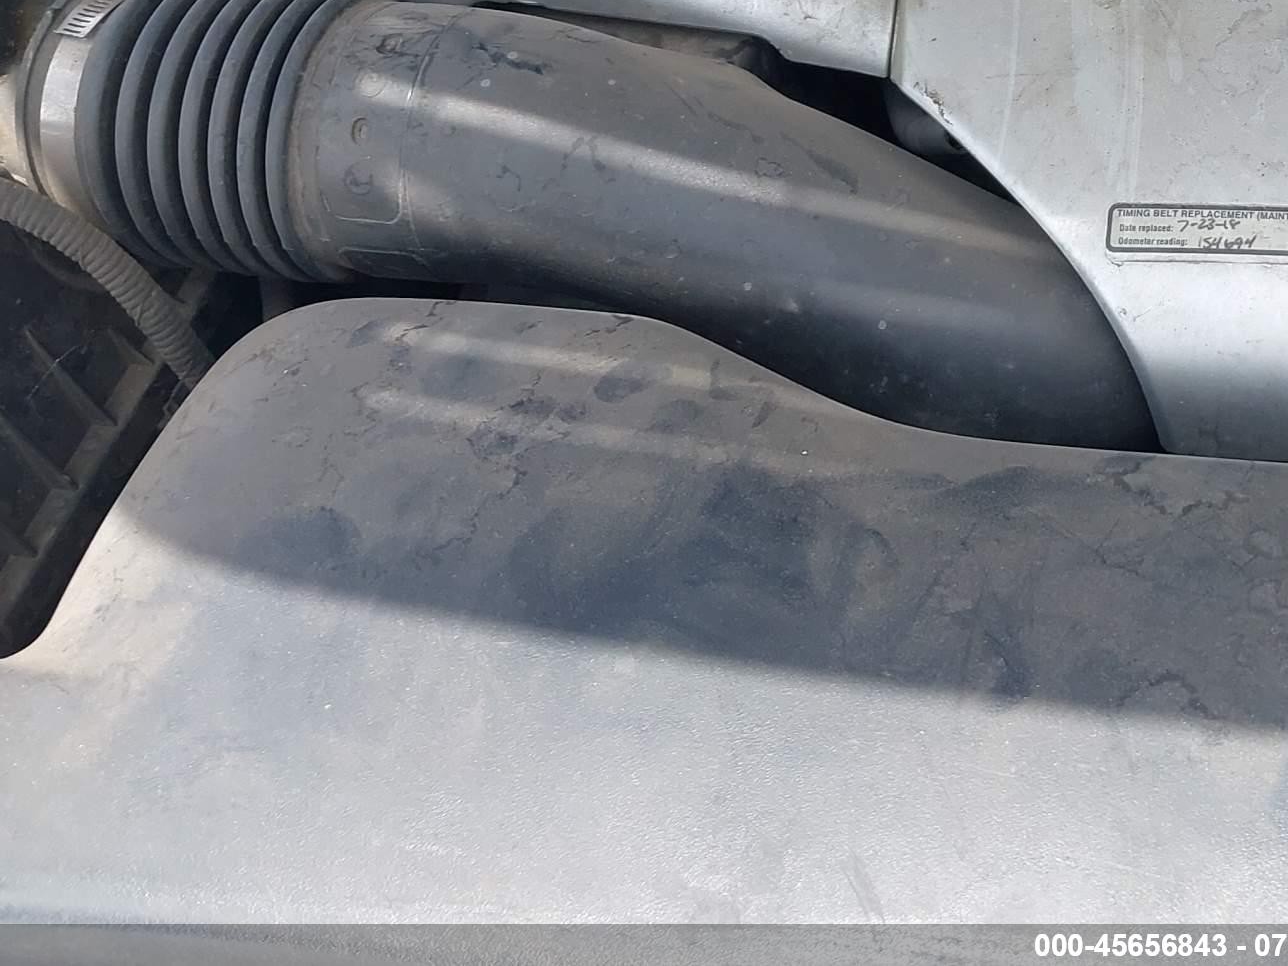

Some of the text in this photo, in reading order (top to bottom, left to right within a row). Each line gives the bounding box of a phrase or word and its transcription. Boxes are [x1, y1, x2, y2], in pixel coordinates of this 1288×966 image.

[1117, 209, 1150, 218] TIMING
[1153, 209, 1179, 218] BELT
[1181, 210, 1255, 219] REPLACEMENT
[1119, 223, 1174, 233] Date replaced:
[1118, 236, 1189, 247] Odometer reading:
